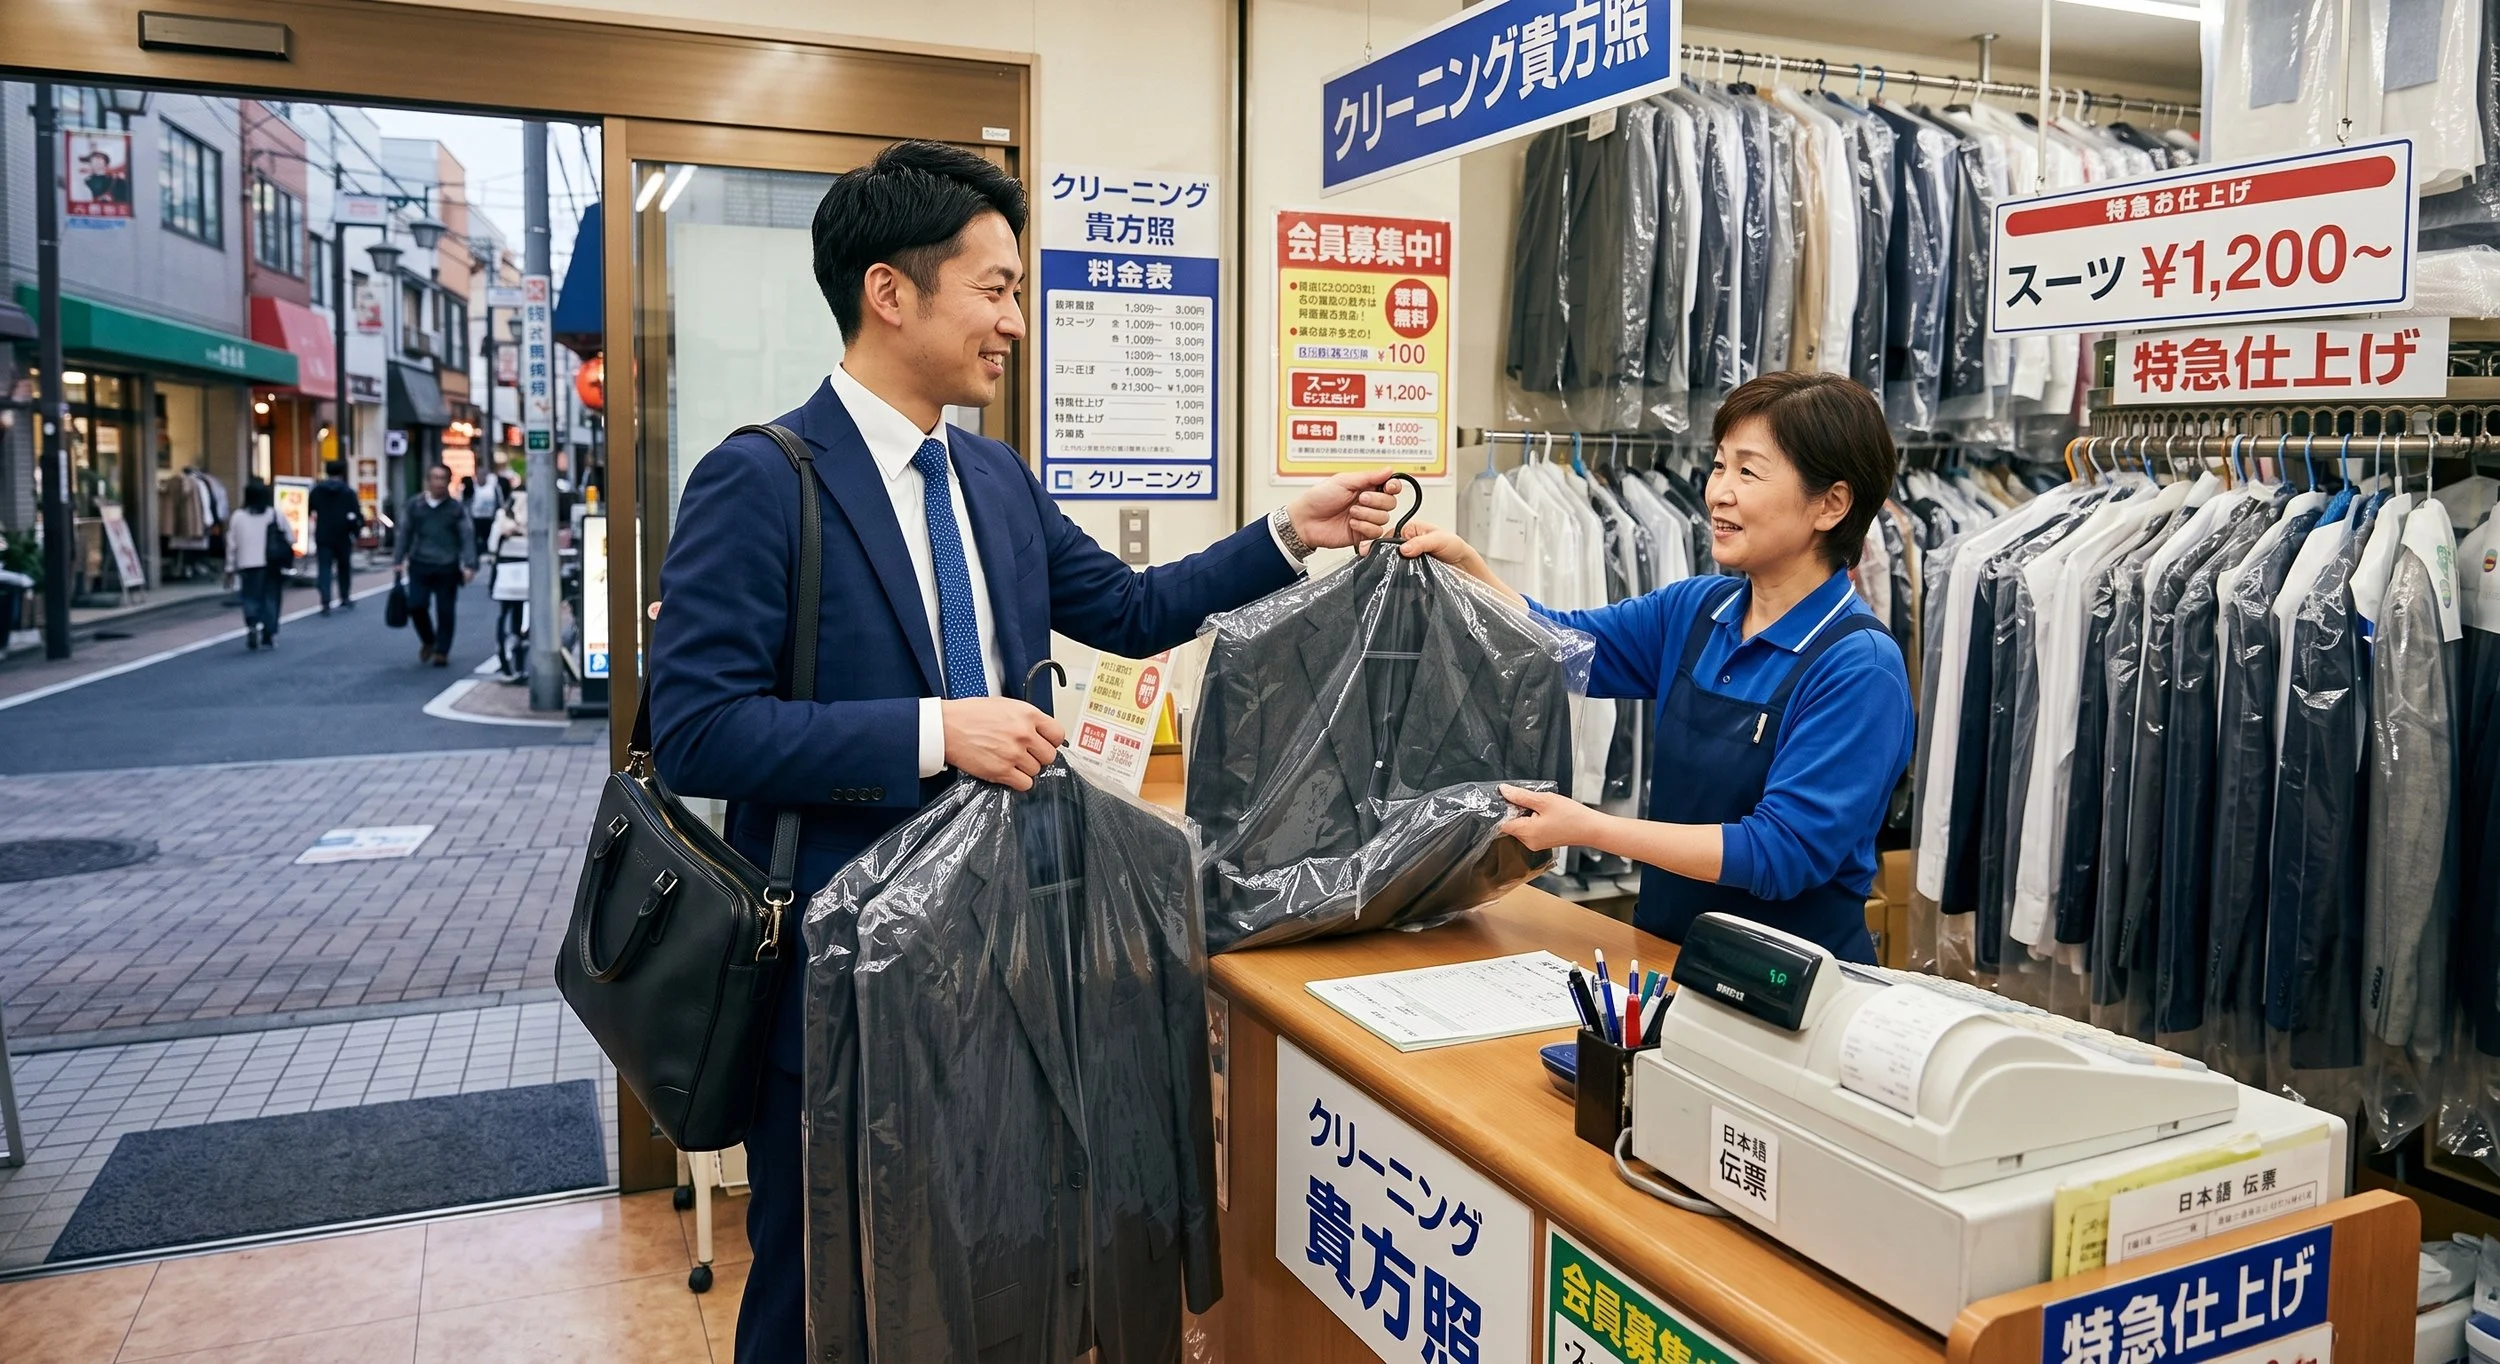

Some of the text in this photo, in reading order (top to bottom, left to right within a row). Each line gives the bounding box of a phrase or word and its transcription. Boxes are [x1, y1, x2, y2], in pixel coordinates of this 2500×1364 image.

[1334, 0, 1650, 162] クリーニング貴方照
[1052, 173, 1209, 208] クリーニング
[2106, 179, 2252, 222] 特急お仕上げ
[1086, 212, 1175, 246] 貴方照
[1287, 221, 1443, 268] 会員募集中!
[1087, 258, 1174, 290] 料金表
[2006, 256, 2126, 308] スーツ
[1307, 376, 1351, 392] スーツ
[2132, 328, 2421, 394] 特急仕上げ
[1088, 470, 1204, 489] クリーニング
[1308, 1097, 1484, 1258] クリーニング
[1719, 1148, 1767, 1202] 伝票
[2242, 1168, 2278, 1197] 伝票
[1305, 1174, 1482, 1364] 貴方照
[2061, 1244, 2316, 1364] 特急仕上げ
